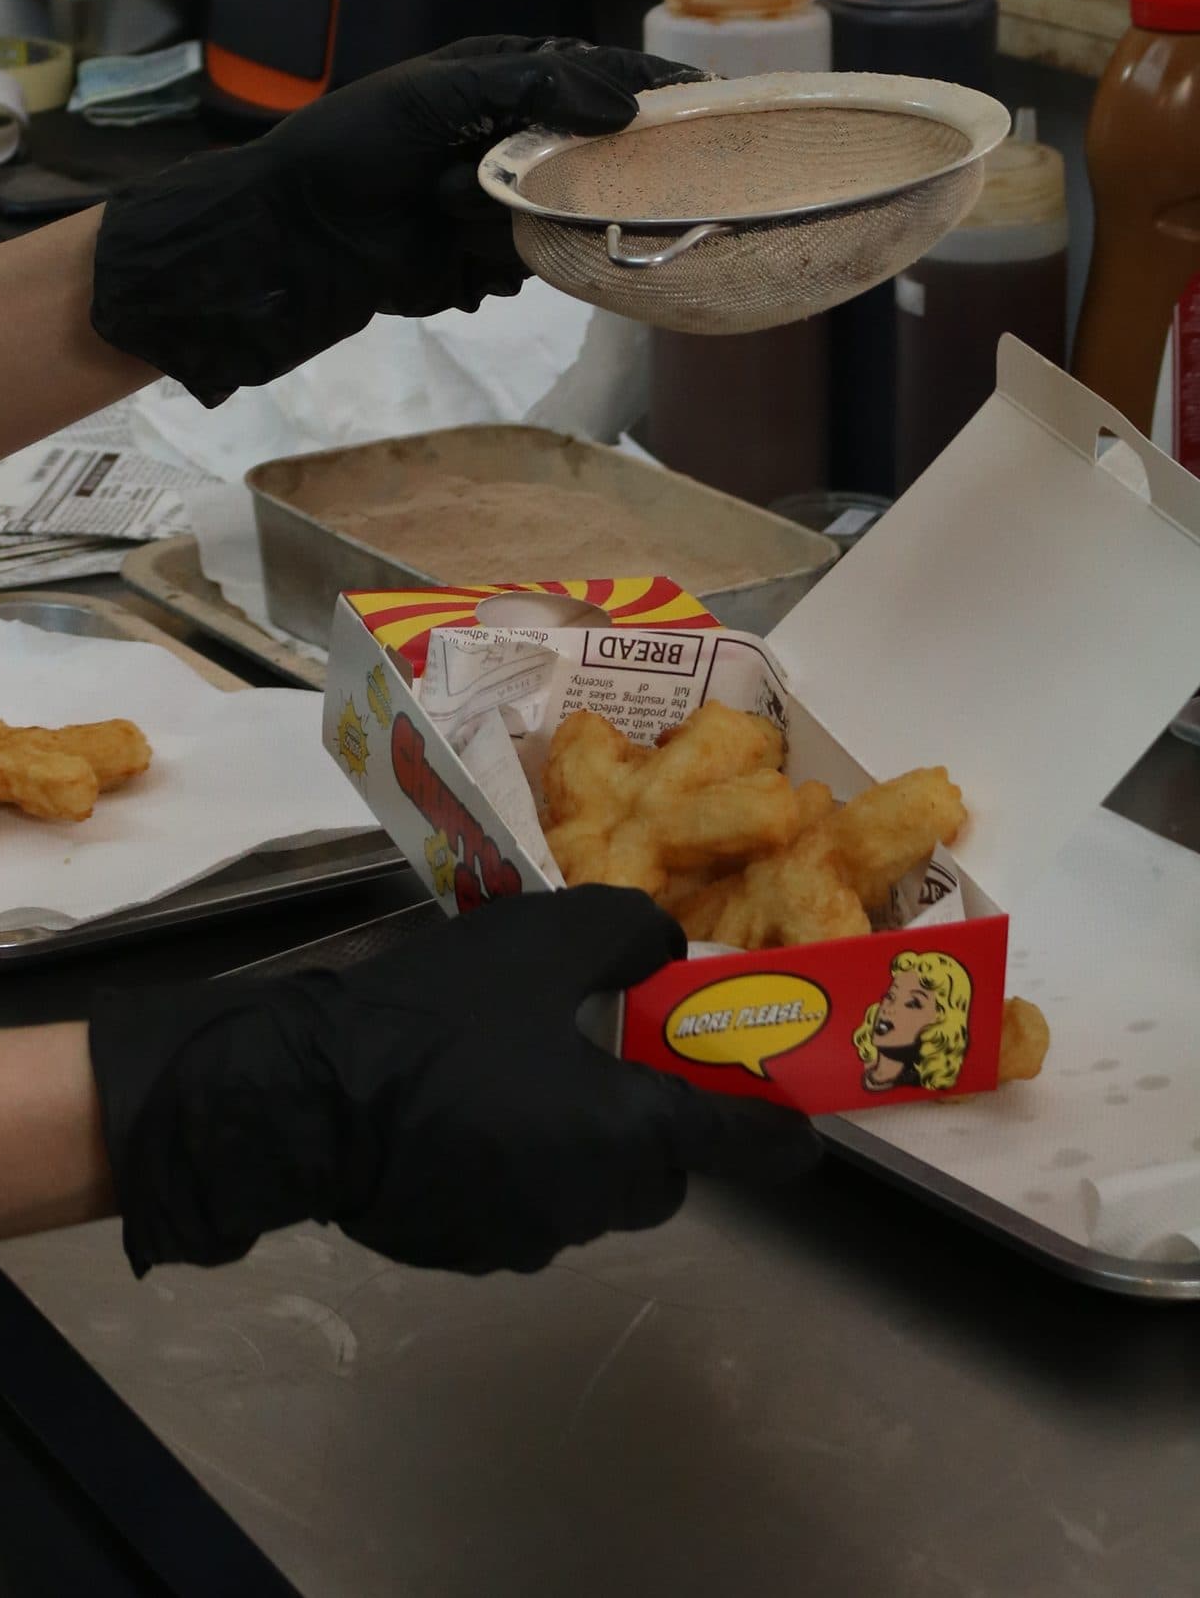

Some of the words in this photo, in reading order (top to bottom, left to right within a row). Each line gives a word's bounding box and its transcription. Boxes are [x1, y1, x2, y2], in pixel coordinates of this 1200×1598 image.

[599, 636, 684, 665] BREAD
[570, 674, 614, 689] sincerity.
[566, 688, 583, 697] are
[638, 682, 650, 694] of
[675, 686, 690, 698] full
[589, 690, 616, 701] cakes
[622, 691, 665, 705] resulting
[562, 699, 583, 710] and
[587, 701, 624, 714] defects,
[671, 697, 687, 708] the
[628, 706, 667, 717] product
[670, 710, 684, 721] for
[632, 718, 653, 729] with
[674, 1009, 733, 1039] MORE
